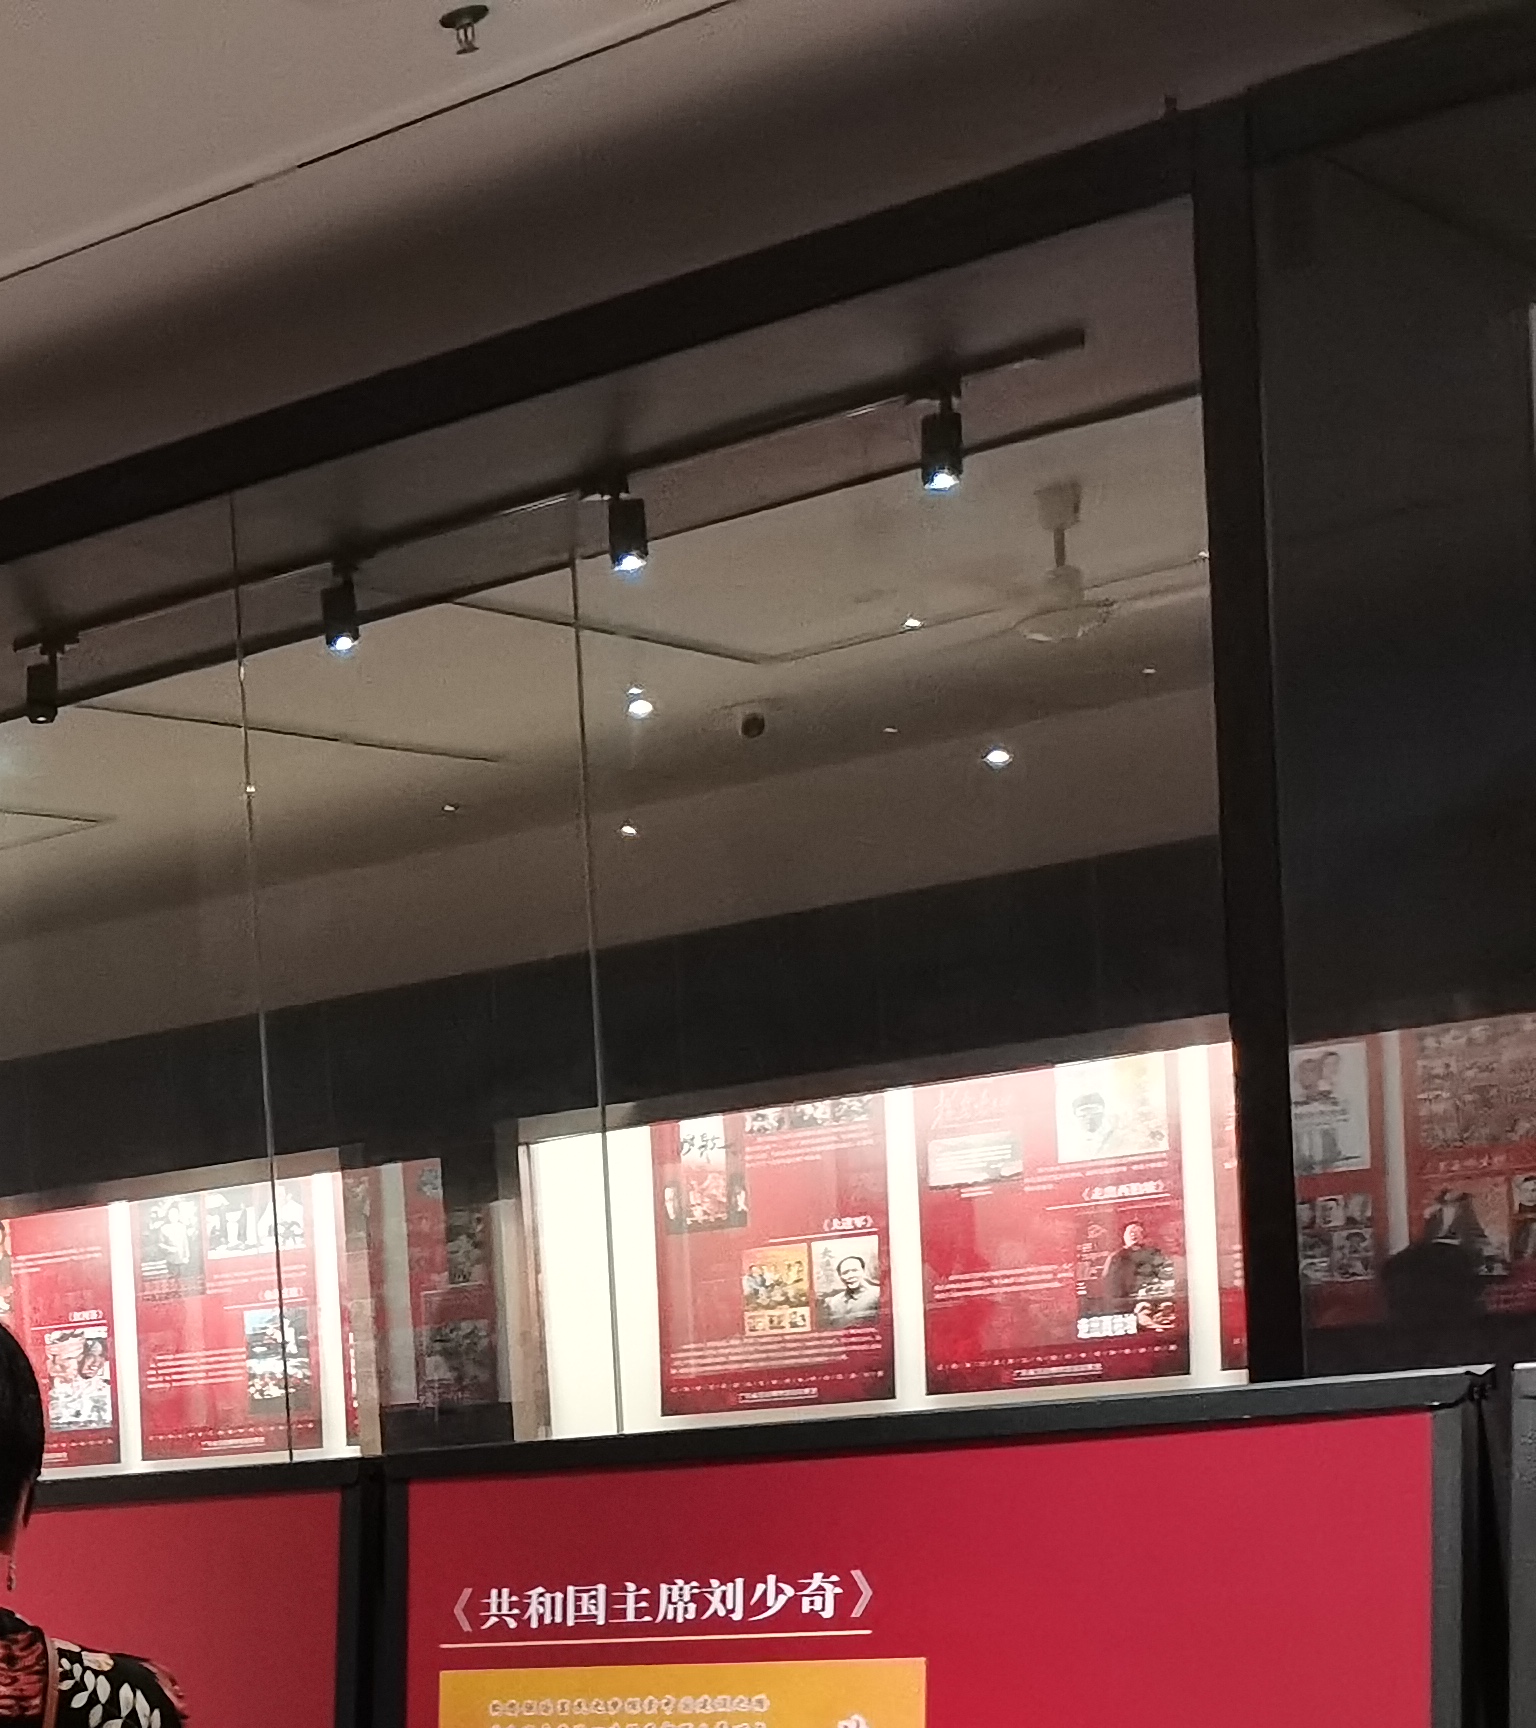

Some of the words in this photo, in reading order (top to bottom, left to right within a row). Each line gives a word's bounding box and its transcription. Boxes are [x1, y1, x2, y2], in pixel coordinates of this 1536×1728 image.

[452, 1568, 874, 1632] 《共和国主席刘少奇》
